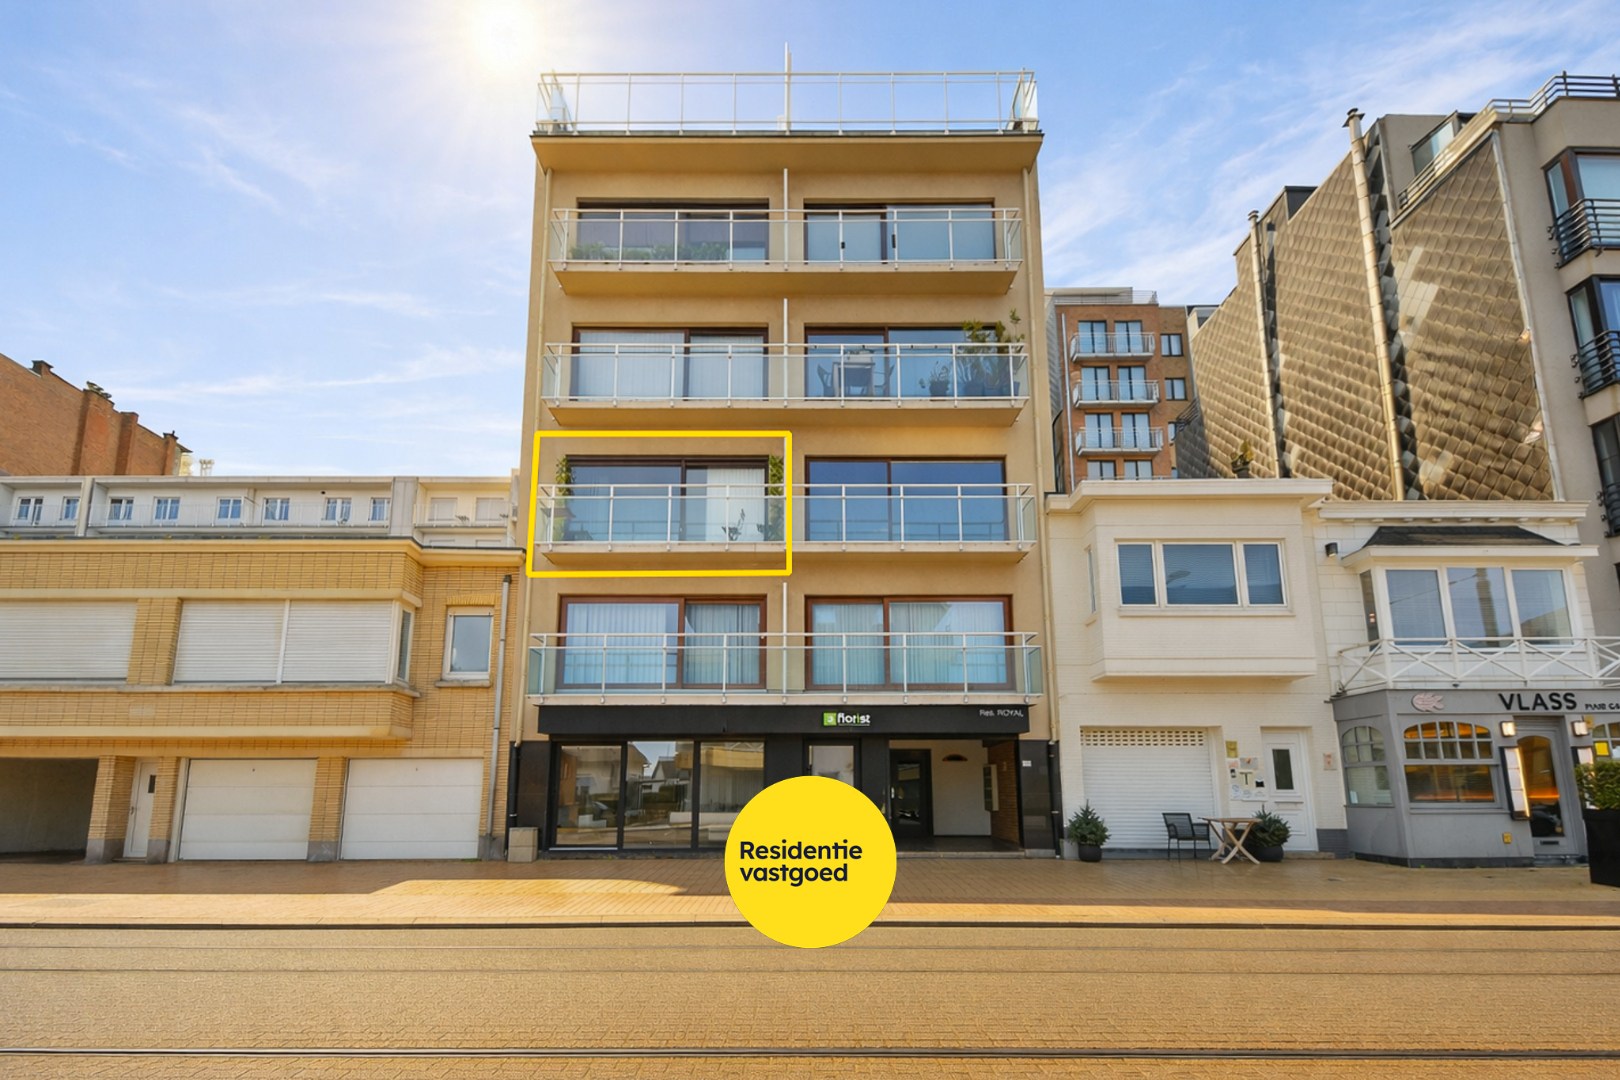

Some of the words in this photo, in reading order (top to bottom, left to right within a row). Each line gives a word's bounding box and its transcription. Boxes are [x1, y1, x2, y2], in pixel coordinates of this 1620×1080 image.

[1498, 692, 1577, 711] VLASS
[837, 712, 871, 724] florist
[996, 709, 1024, 718] ROYAL
